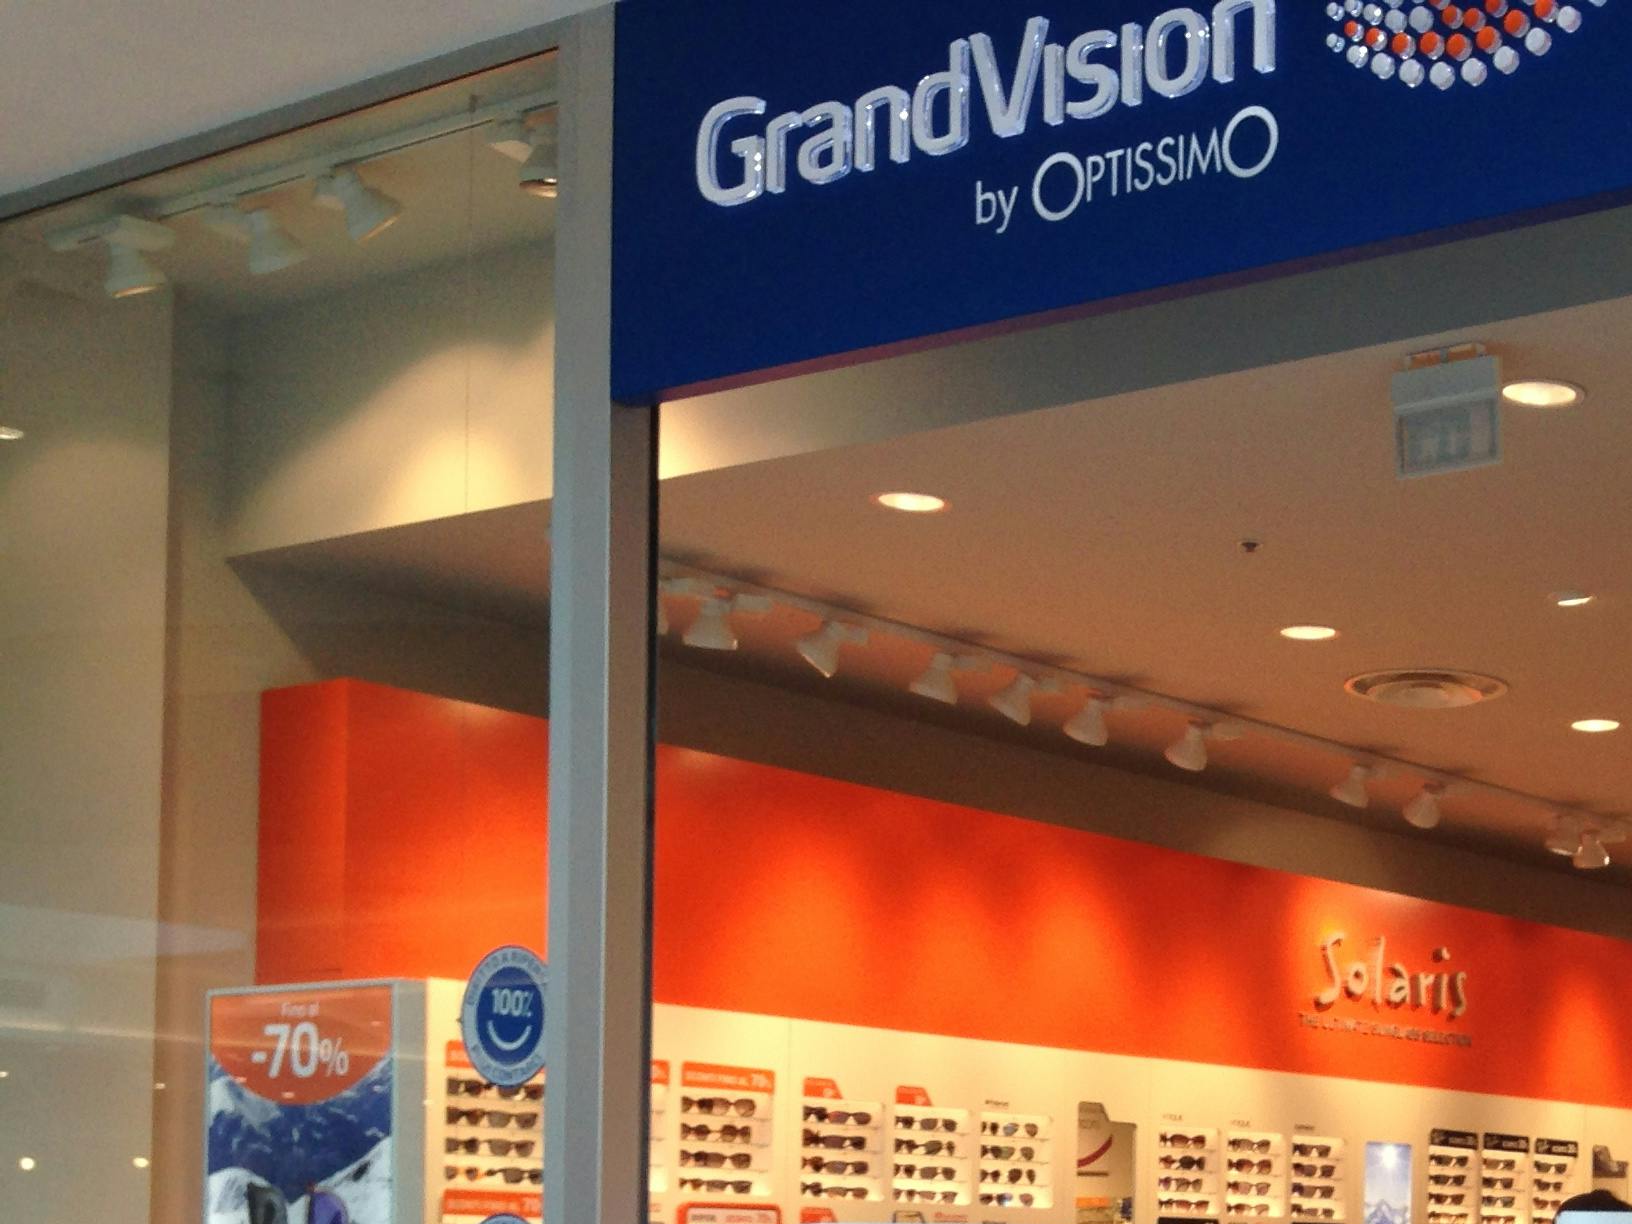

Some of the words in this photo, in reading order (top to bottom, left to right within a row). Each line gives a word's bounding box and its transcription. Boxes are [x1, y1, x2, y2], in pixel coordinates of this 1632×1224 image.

[696, 0, 1276, 206] GrandVision
[975, 181, 1018, 233] by
[1032, 105, 1278, 221] OPTISSIMO
[492, 988, 533, 1017] 100%
[1317, 931, 1468, 1016] Solaris
[251, 1021, 349, 1080] -70%
